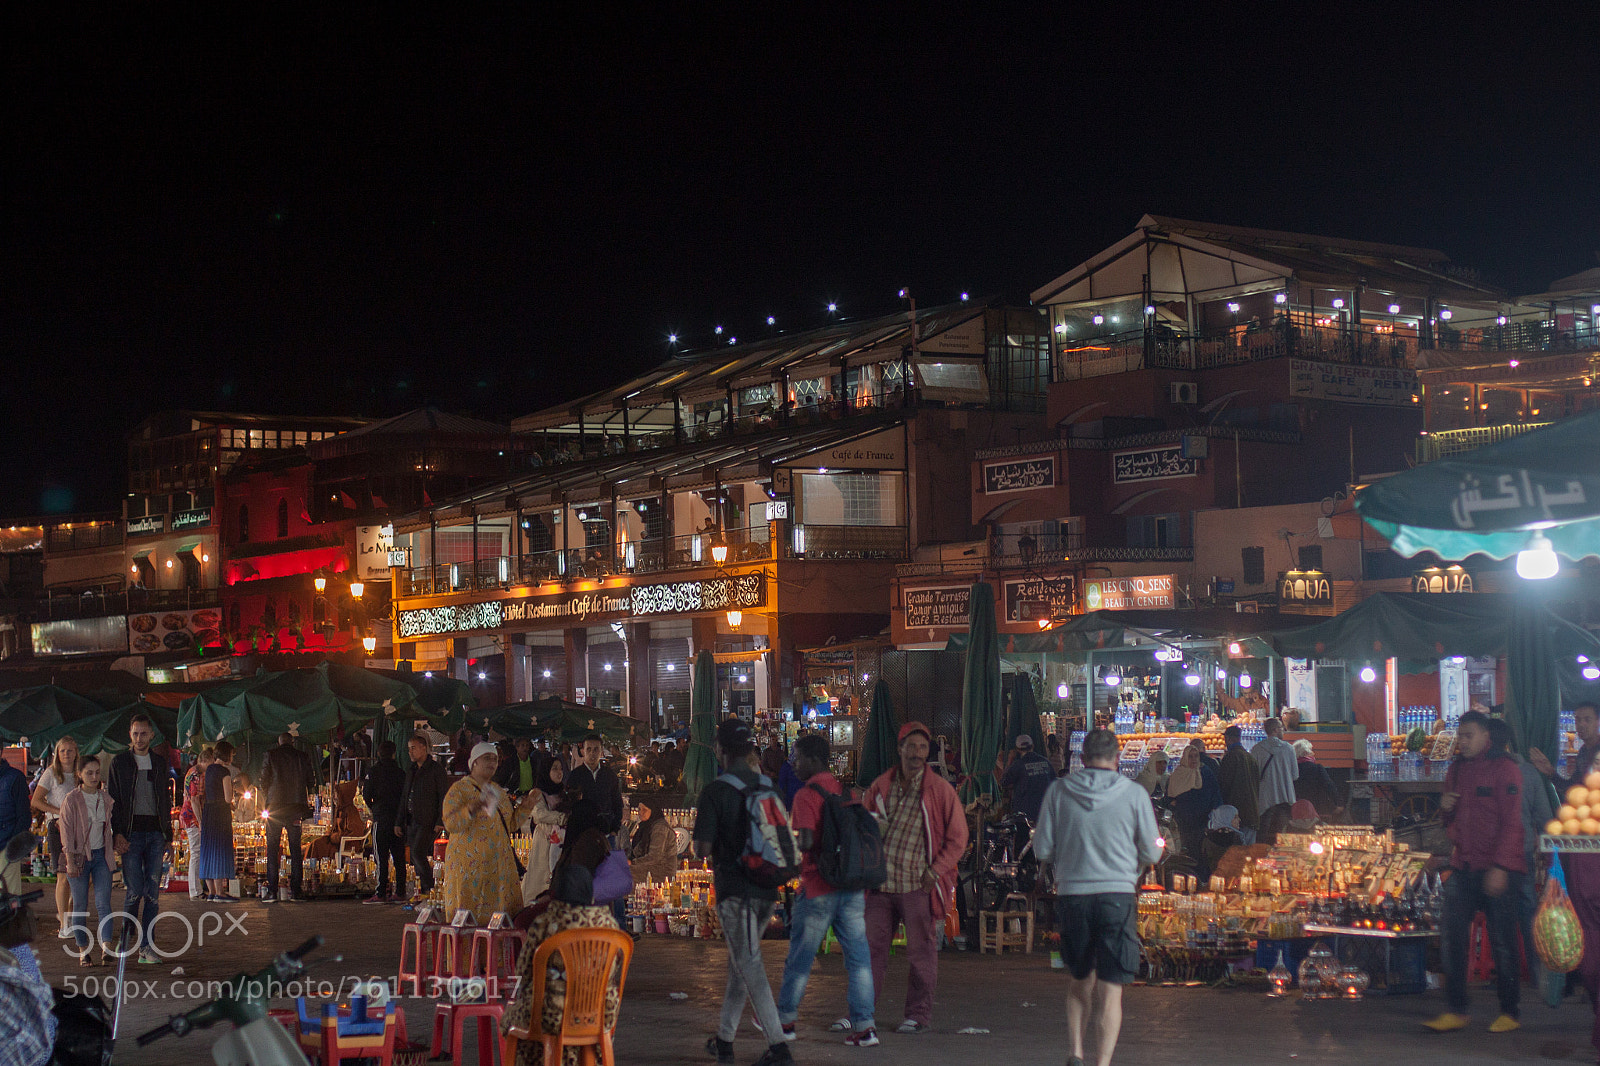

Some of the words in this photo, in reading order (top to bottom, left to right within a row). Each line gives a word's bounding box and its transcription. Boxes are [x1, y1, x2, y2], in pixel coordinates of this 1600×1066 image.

[1321, 374, 1356, 386] CAFE
[832, 450, 851, 463] Café
[853, 450, 863, 459] de
[866, 450, 894, 460] France
[1451, 470, 1588, 530] مراكش
[1102, 581, 1117, 593] LES
[1118, 579, 1149, 594] CINQ
[1148, 578, 1171, 591] SENS
[1283, 579, 1330, 600] AQUA
[1416, 574, 1473, 593] AQUA
[907, 591, 933, 604] Grande
[934, 591, 969, 602] Terrasse
[1104, 597, 1134, 608] BEAUTY
[1136, 595, 1170, 607] CENTER
[503, 601, 525, 621] Hôtel
[525, 600, 571, 619] Restaurant
[570, 594, 589, 621] Café
[590, 594, 601, 613] de
[601, 595, 630, 612] France
[909, 615, 930, 625] Café
